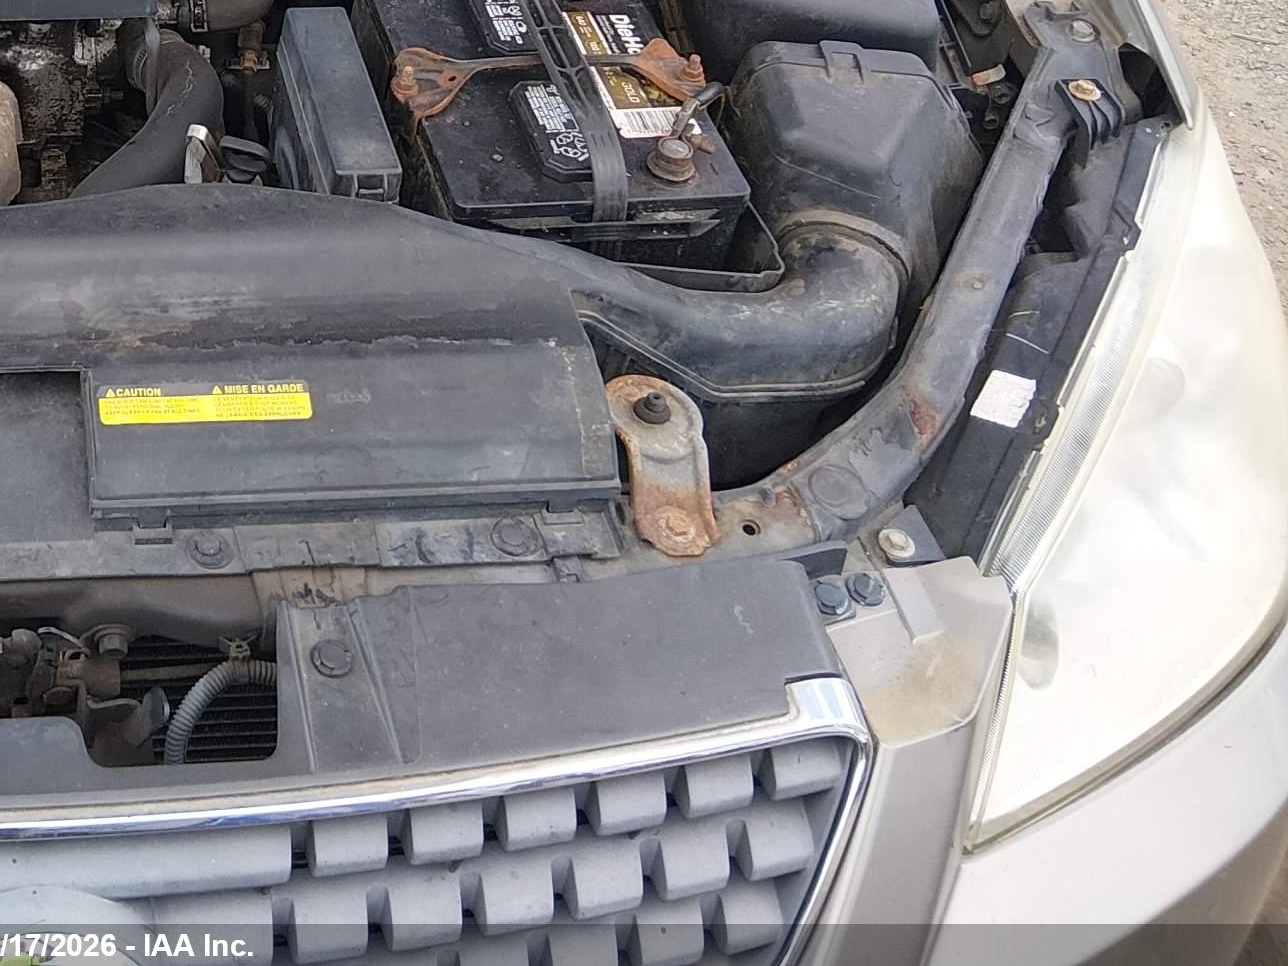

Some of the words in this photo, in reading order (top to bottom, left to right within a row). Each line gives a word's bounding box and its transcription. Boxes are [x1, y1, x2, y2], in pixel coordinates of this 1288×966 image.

[608, 14, 644, 54] DieH
[621, 81, 640, 103] GOLD
[116, 387, 161, 397] CAUTION
[224, 384, 249, 394] MISE
[251, 384, 266, 394] EN
[267, 383, 304, 393] GARDE
